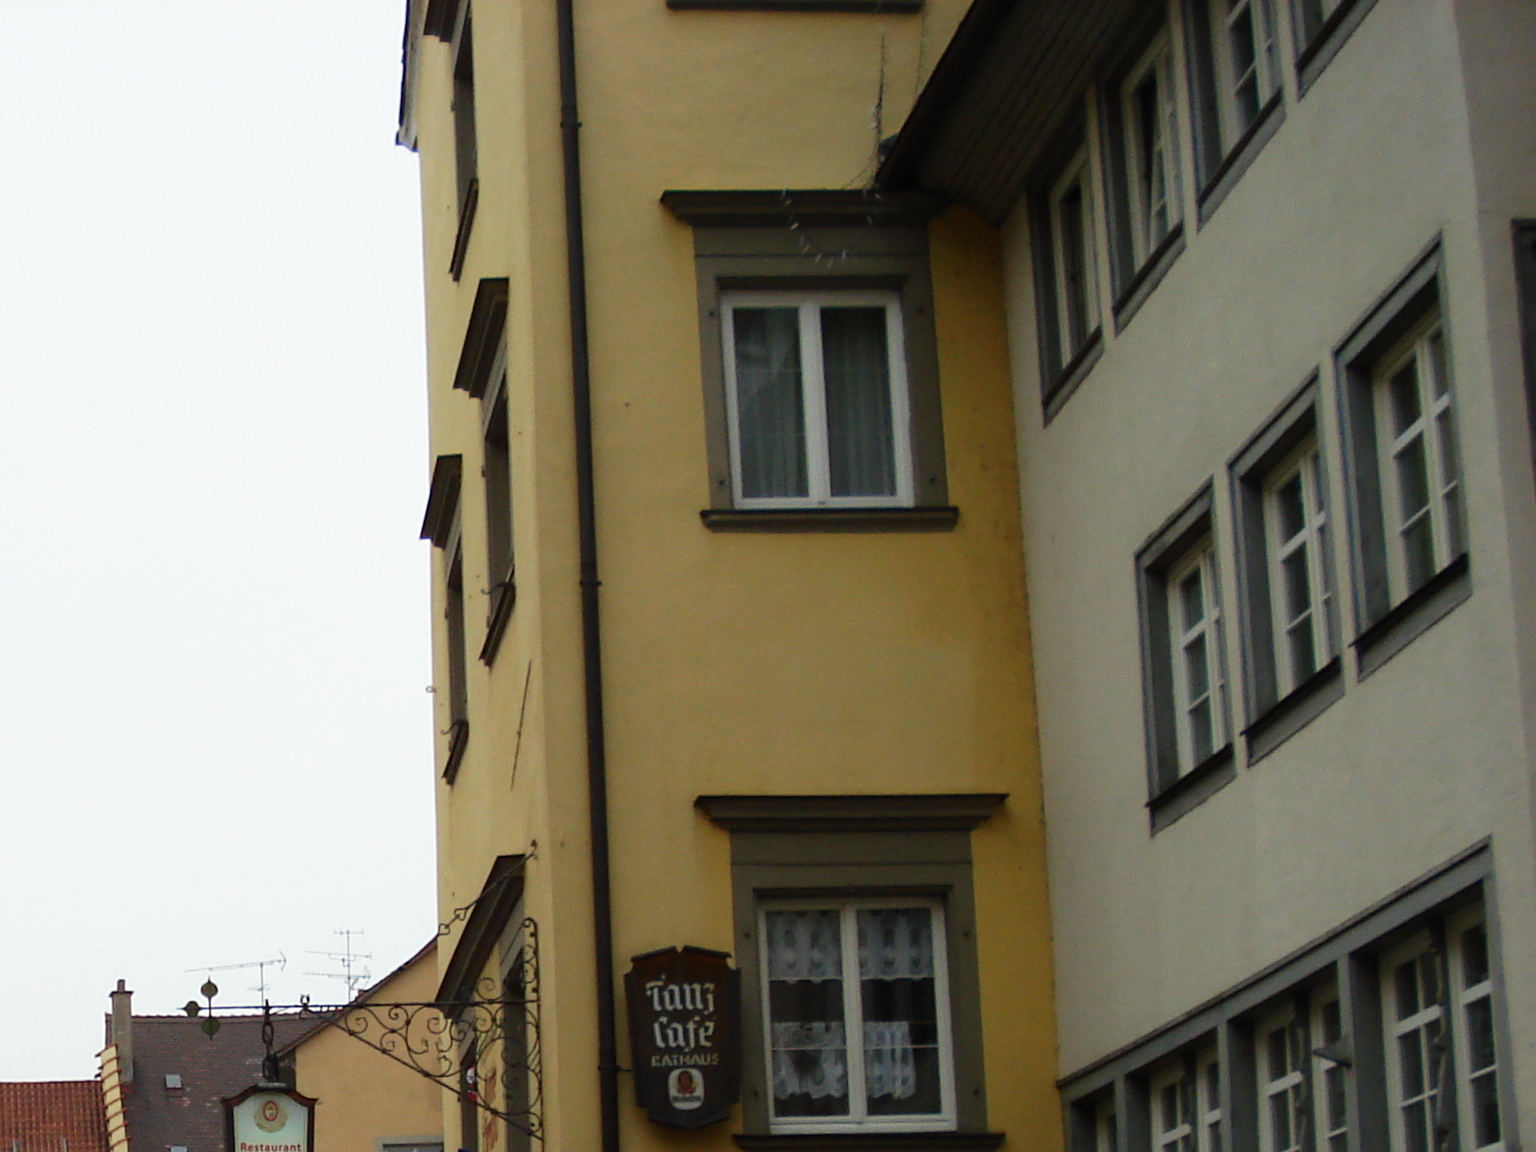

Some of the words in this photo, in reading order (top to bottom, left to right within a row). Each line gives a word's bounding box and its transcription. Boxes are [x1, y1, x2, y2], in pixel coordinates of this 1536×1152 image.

[645, 973, 715, 1015] Tanz
[650, 1053, 719, 1067] RATHAUS
[240, 1143, 302, 1152] Restaurant
